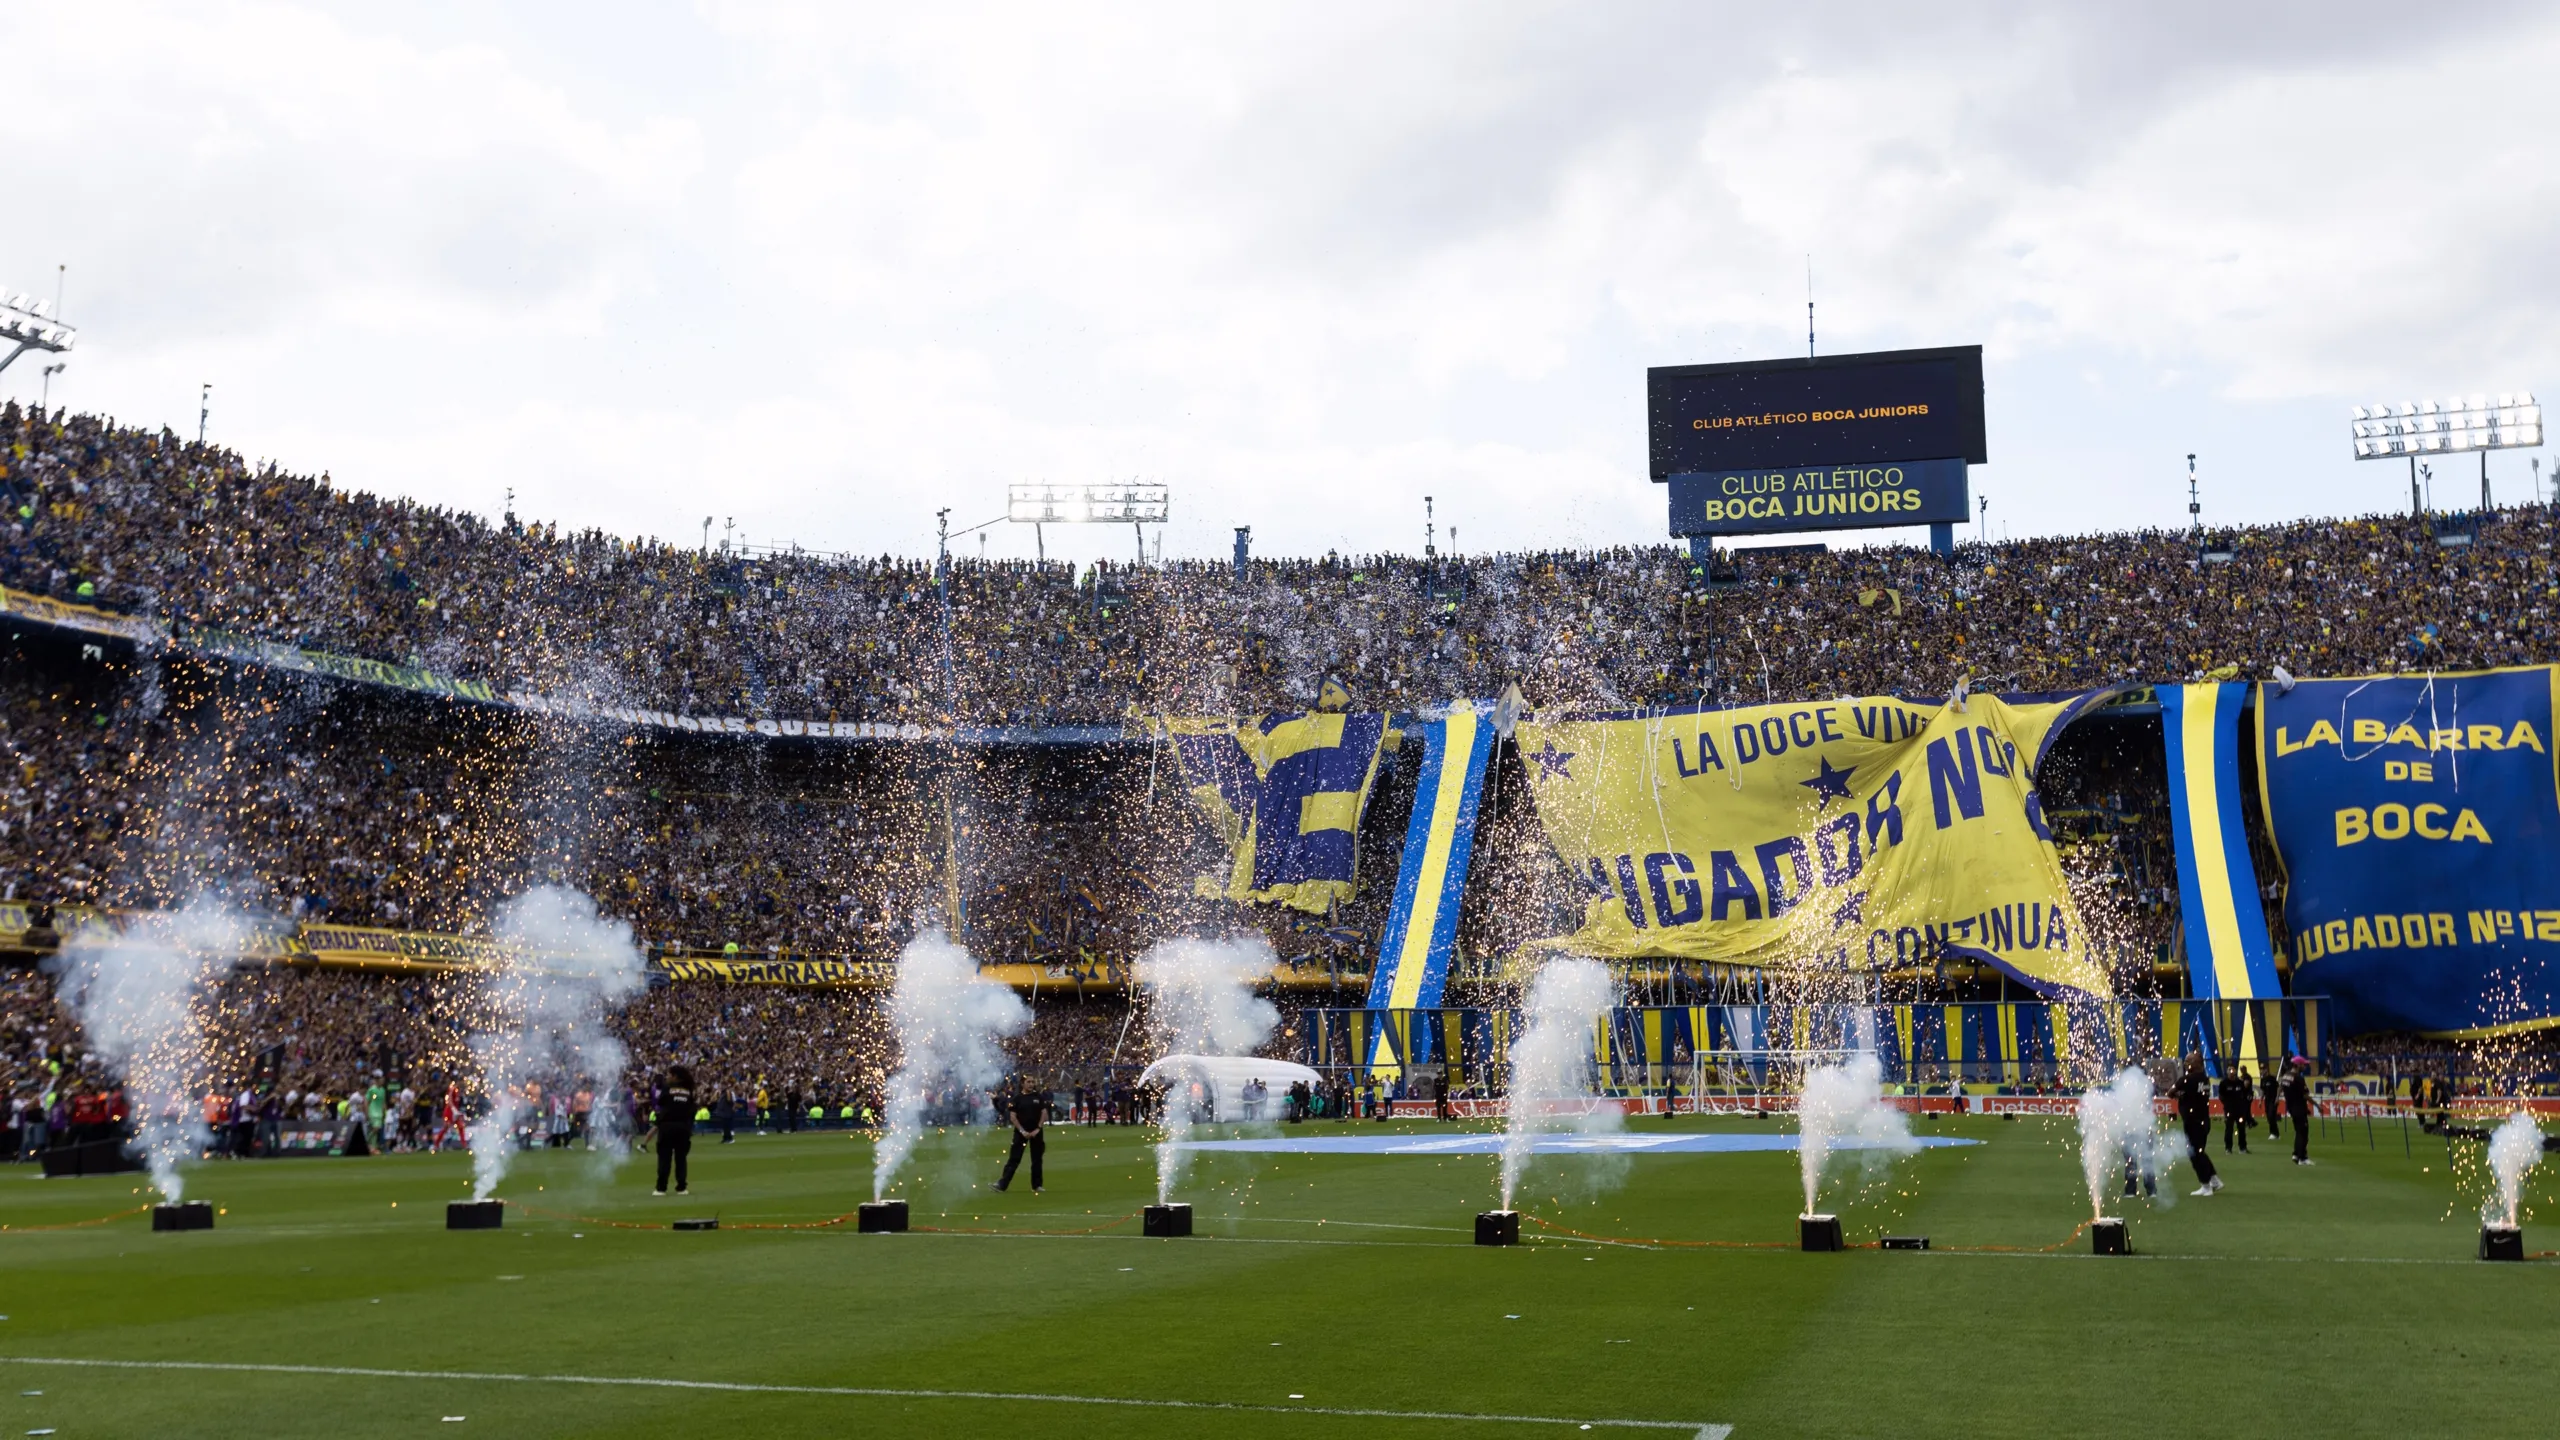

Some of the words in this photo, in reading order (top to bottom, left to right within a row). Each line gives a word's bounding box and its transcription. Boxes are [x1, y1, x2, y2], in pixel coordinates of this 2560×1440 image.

[1693, 416, 1732, 429] CLUB
[1736, 412, 1808, 426] ATLÉTICO
[1812, 409, 1856, 422] BOCA
[1858, 404, 1929, 418] JUNIORS
[1722, 474, 1786, 495] CLUB
[1793, 467, 1904, 491] ATLÉTICO
[1706, 496, 1785, 521] BOCA
[1793, 488, 1922, 516] JUNIORS
[1673, 732, 1724, 778] LA
[1732, 707, 1843, 764] DOCE
[2276, 719, 2341, 757] LA
[2353, 719, 2545, 754] BARRA
[2385, 761, 2433, 782] DE
[2335, 803, 2493, 847] BOCA
[1572, 769, 1904, 932] UGADOR
[1991, 1100, 2078, 1115] betsson
